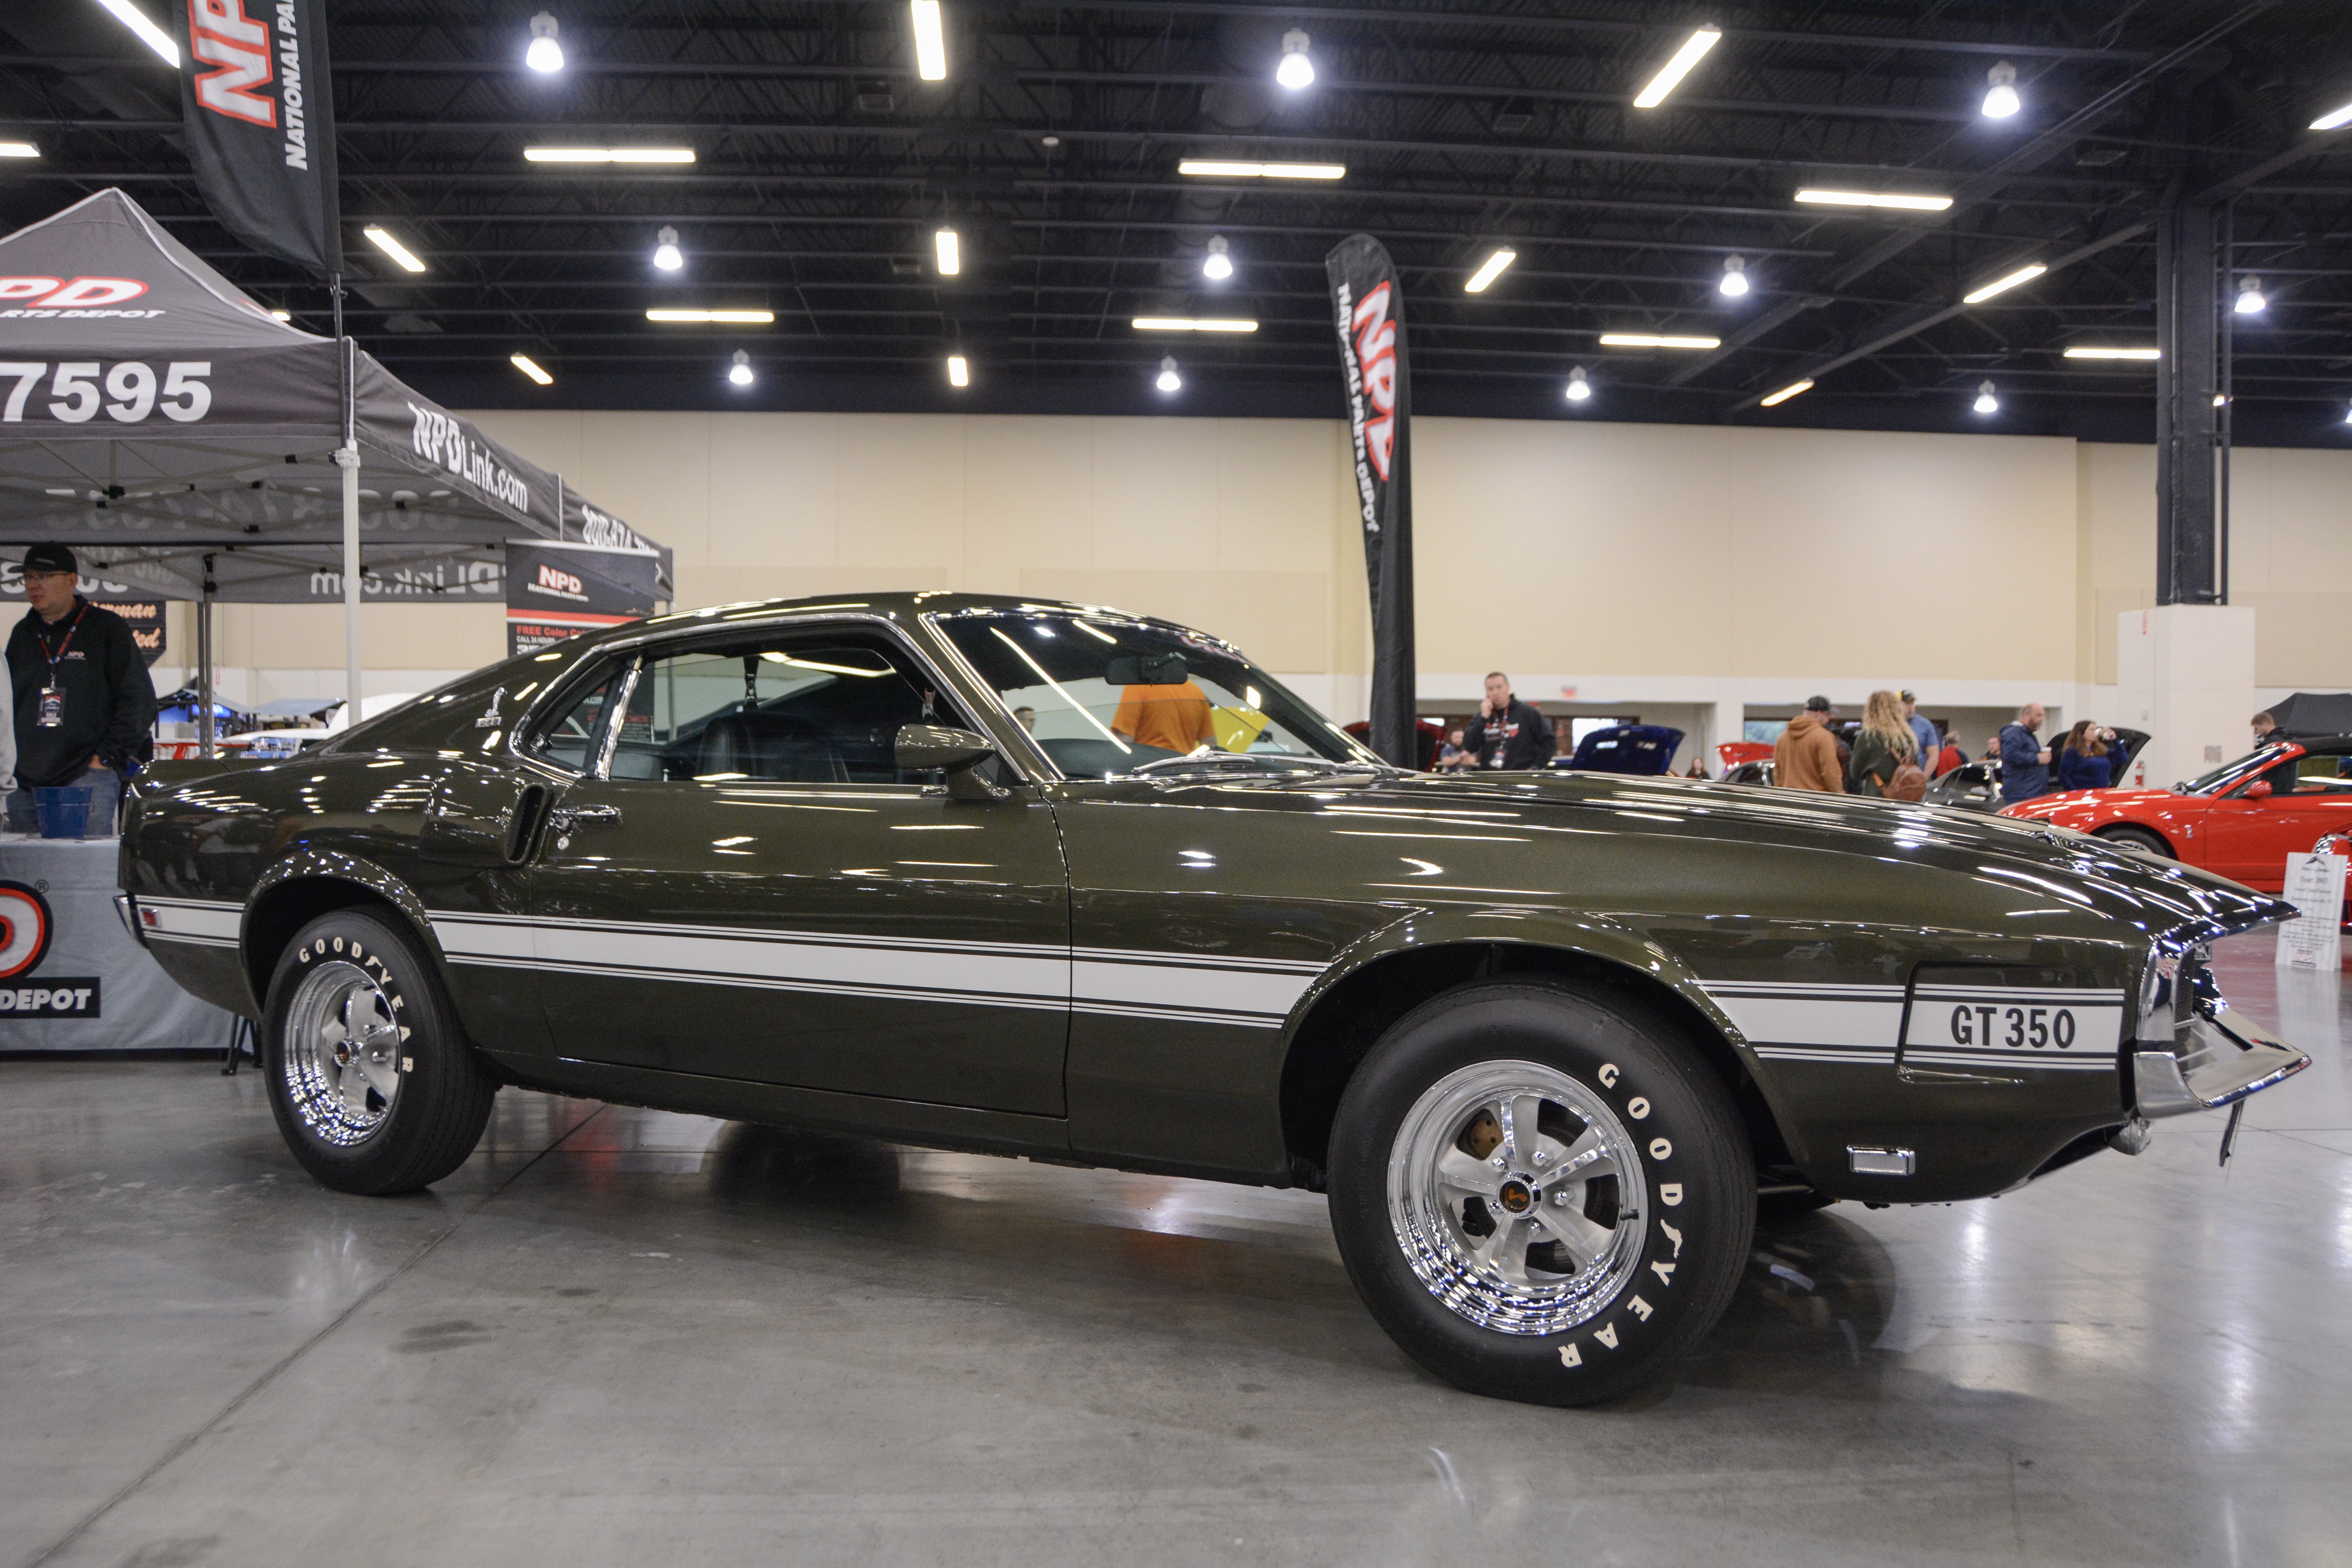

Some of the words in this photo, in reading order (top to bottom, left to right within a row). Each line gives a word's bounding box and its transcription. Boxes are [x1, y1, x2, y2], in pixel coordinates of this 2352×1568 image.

[276, 0, 297, 36] PA
[279, 38, 307, 170] NATIONAL
[59, 310, 166, 318] DEPOT
[408, 401, 528, 513] NPDLink.com
[1357, 462, 1379, 533] DEPOT
[528, 583, 561, 597] NATIONAL
[539, 564, 583, 594] NPD
[516, 625, 542, 636] FREE
[544, 627, 568, 637] Color
[516, 635, 530, 644] CALL
[0, 988, 93, 1010] DEPOT
[299, 937, 414, 1073] GOODYEAR
[1951, 1005, 1997, 1046] GT
[2005, 1008, 2075, 1049] 350
[1558, 1063, 1683, 1368] GOODYEAR
